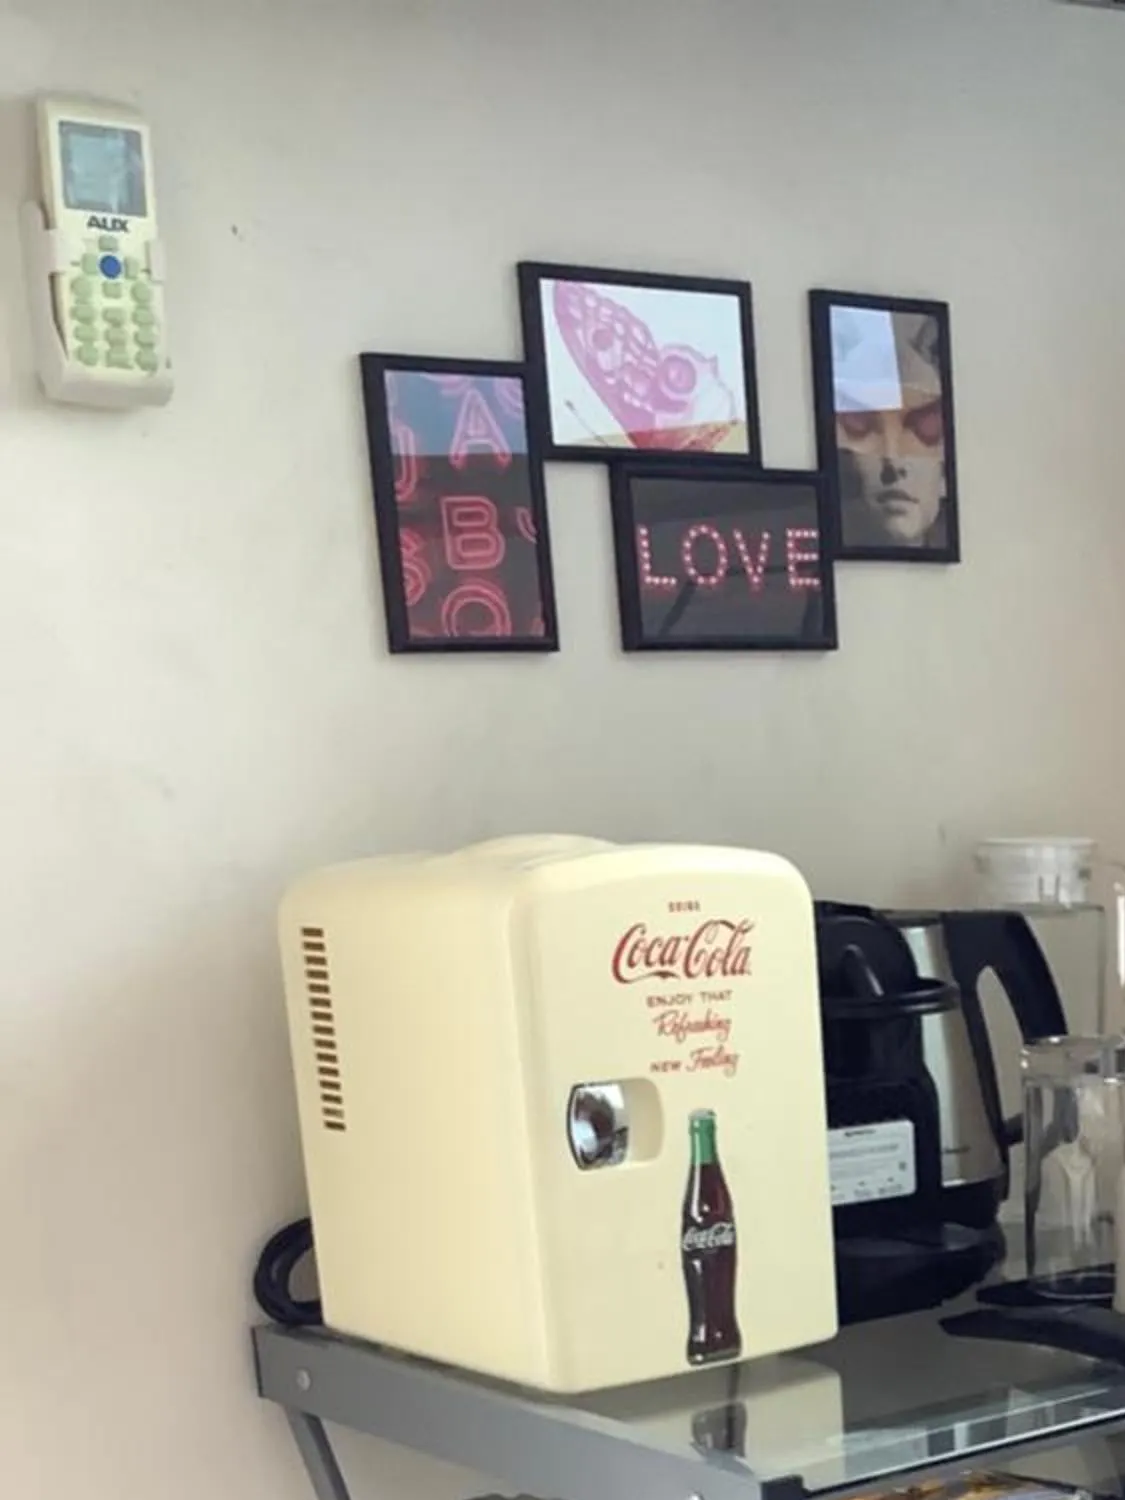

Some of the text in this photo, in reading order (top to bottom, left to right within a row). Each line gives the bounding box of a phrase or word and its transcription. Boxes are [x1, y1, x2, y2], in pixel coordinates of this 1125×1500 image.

[87, 215, 129, 233] AUX
[636, 524, 821, 590] LOVE
[612, 918, 755, 984] Coca-Cola
[646, 989, 732, 1008] ENJOY THAT
[650, 1060, 682, 1073] NEW
